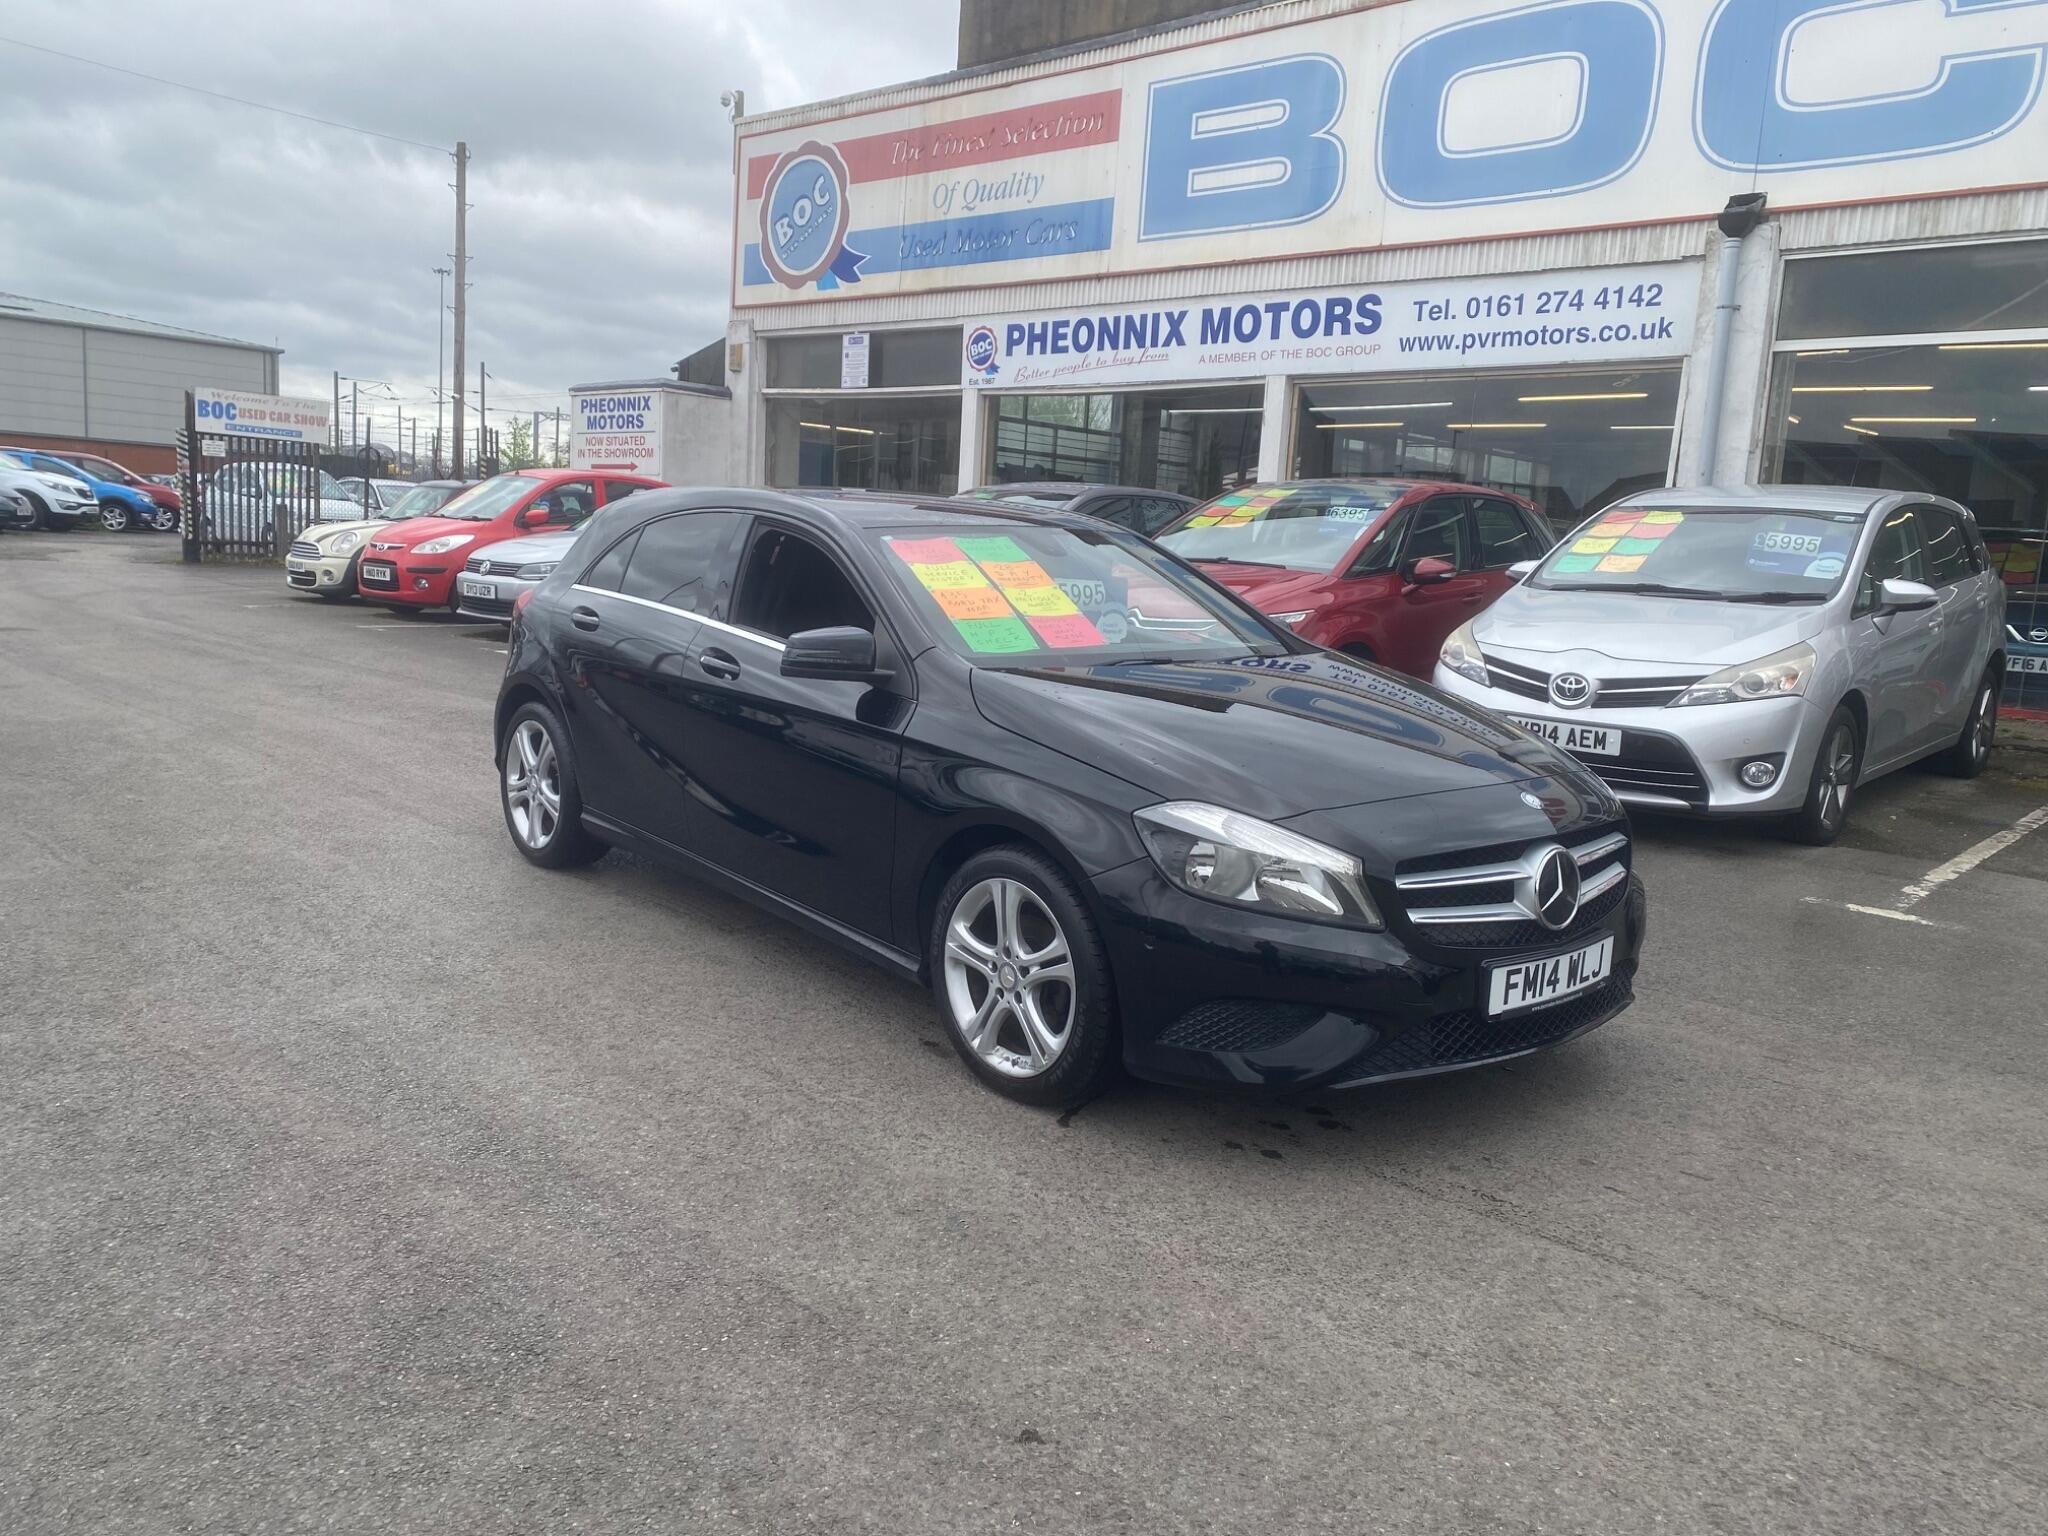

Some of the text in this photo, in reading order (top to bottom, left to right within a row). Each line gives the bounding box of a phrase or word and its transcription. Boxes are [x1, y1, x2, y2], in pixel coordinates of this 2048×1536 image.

[1138, 0, 2048, 243] BOC
[892, 110, 1105, 165] The Finest Selection
[933, 171, 1045, 215] Of Quality
[774, 175, 830, 249] BOC
[898, 217, 1079, 260] Used Motor Cars
[1413, 282, 1664, 322] Tel. 0161 274 4142
[1005, 293, 1383, 357] PHEONNIX MOTORS
[1398, 316, 1674, 355] www.pvrmotors.co.uk
[970, 338, 993, 356] BOC
[1198, 343, 1382, 365] A MEMBER OF THE BOC GROUP
[1014, 346, 1169, 384] Better people to buy from
[197, 398, 328, 428] BOC USED CAR SHOW
[210, 391, 267, 406] Welcome
[294, 400, 317, 410] The
[580, 396, 652, 414] PHEONNIX
[226, 424, 301, 437] ENTRANCE
[586, 413, 644, 430] MOTORS
[577, 447, 654, 459] IN THE SHOWROOM
[585, 435, 646, 447] NOW SITUATED
[375, 568, 387, 580] RYK
[1565, 727, 1607, 751] AEM
[1503, 958, 1560, 1006] FM14
[1566, 942, 1605, 990] WLJ
